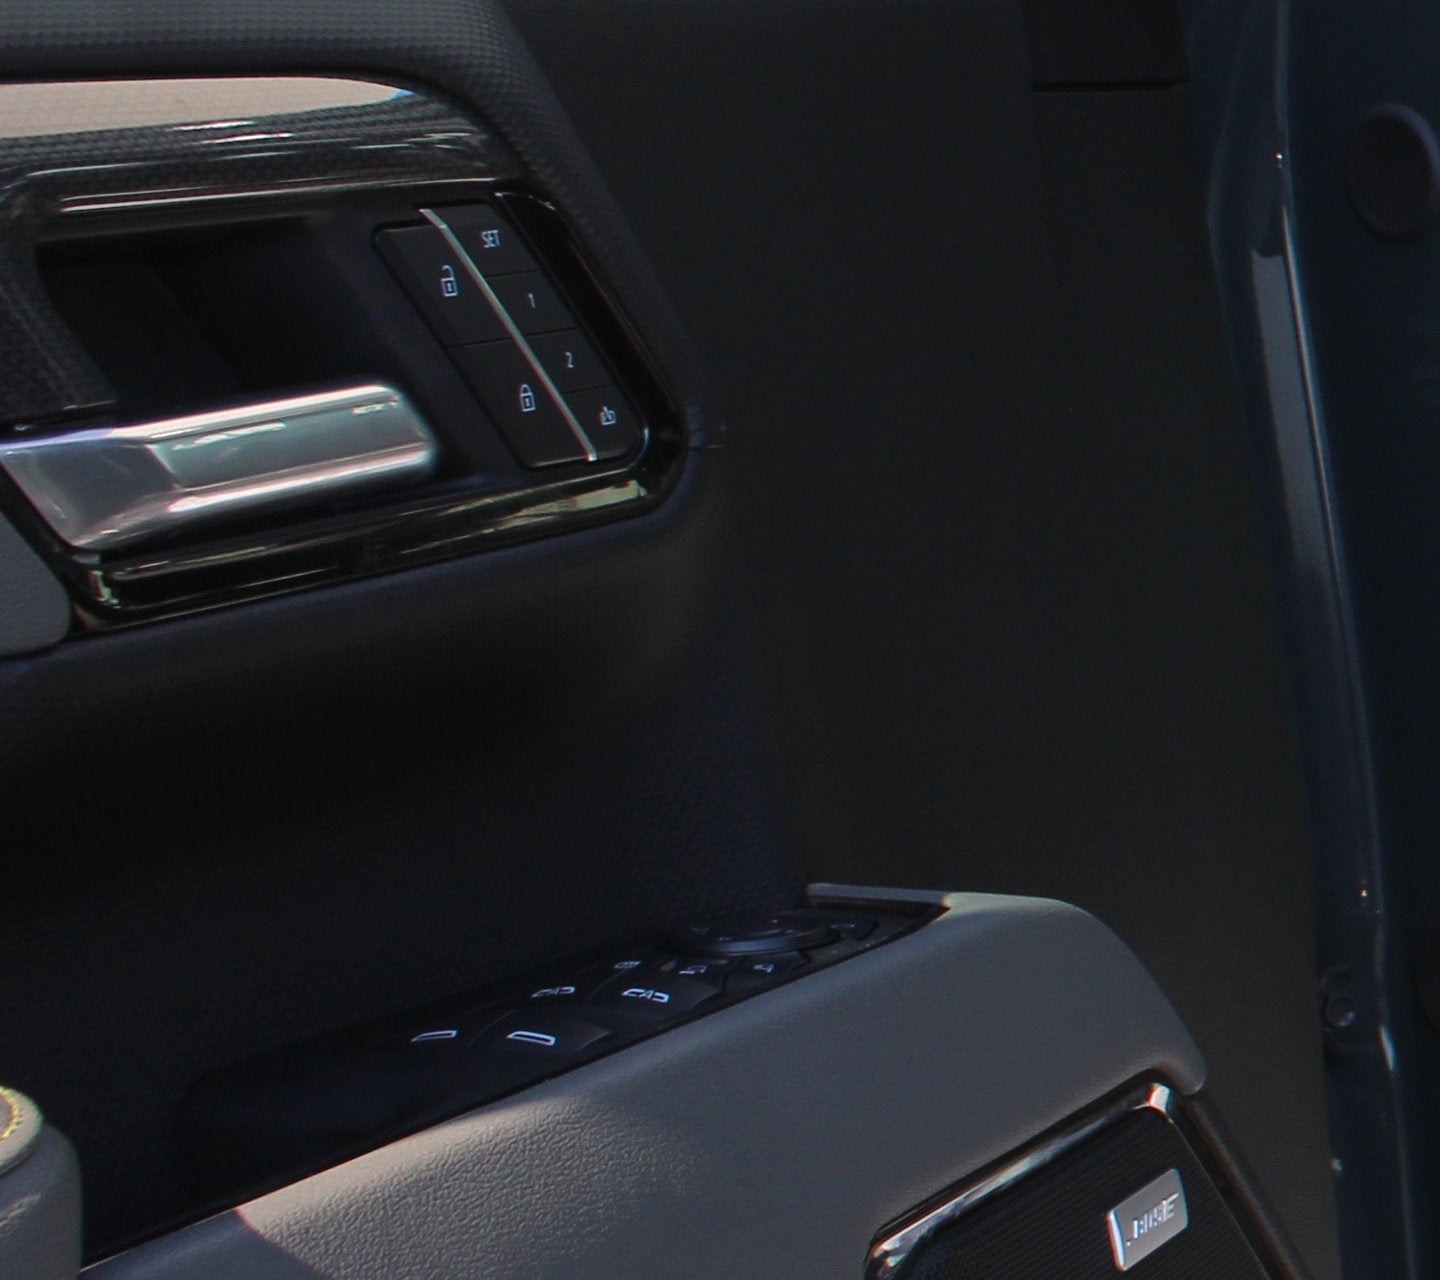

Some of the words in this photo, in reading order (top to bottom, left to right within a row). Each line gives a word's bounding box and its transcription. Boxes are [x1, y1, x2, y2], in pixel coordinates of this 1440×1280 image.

[481, 229, 500, 249] SET
[528, 292, 537, 309] 1
[564, 351, 575, 369] 2
